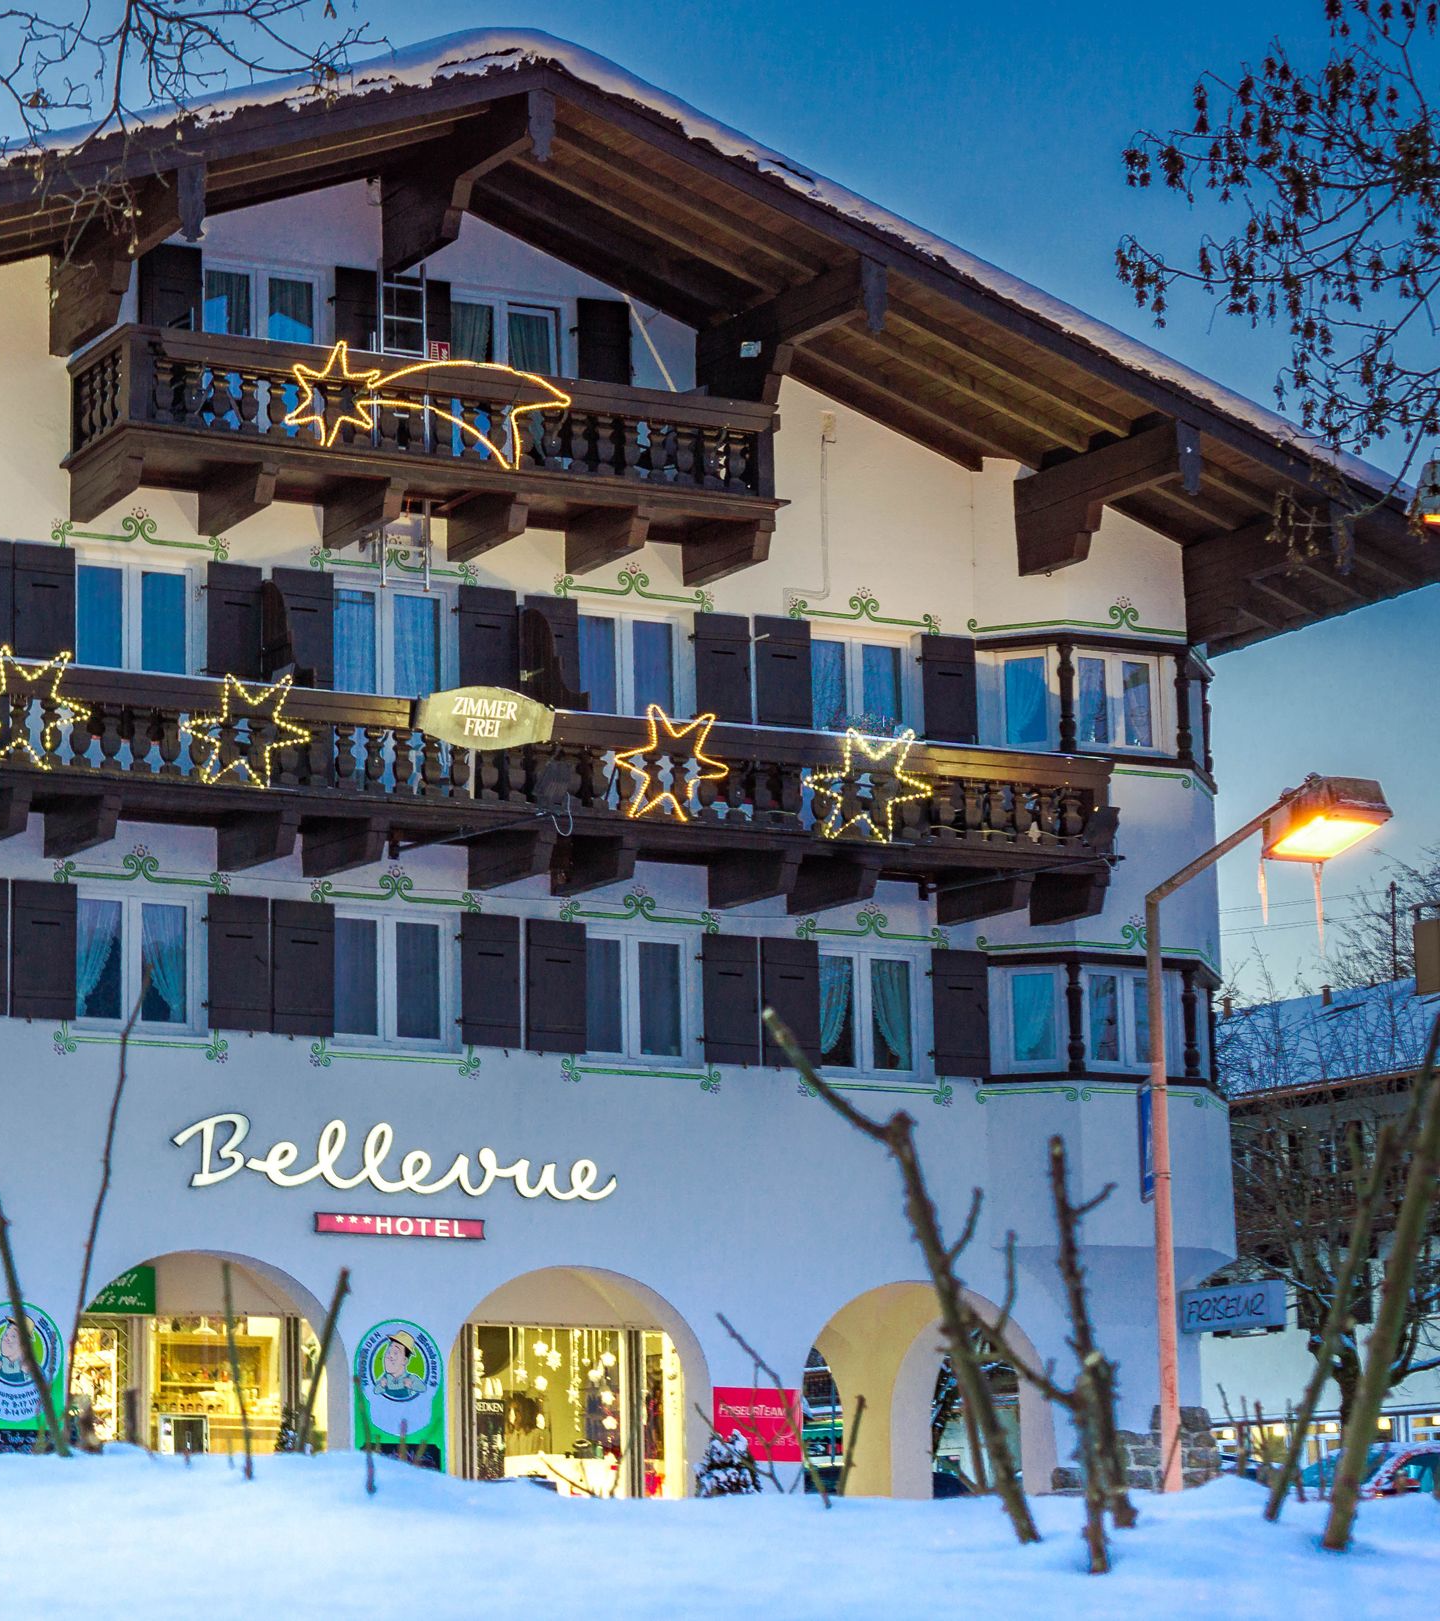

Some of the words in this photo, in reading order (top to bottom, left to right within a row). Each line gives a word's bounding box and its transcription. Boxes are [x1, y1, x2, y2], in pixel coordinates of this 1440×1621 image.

[451, 696, 518, 721] ZIMMER
[463, 718, 501, 738] FREI
[169, 1113, 617, 1201] Bellevue
[375, 1216, 467, 1238] HOTEL
[1186, 1292, 1265, 1323] FRISEUR
